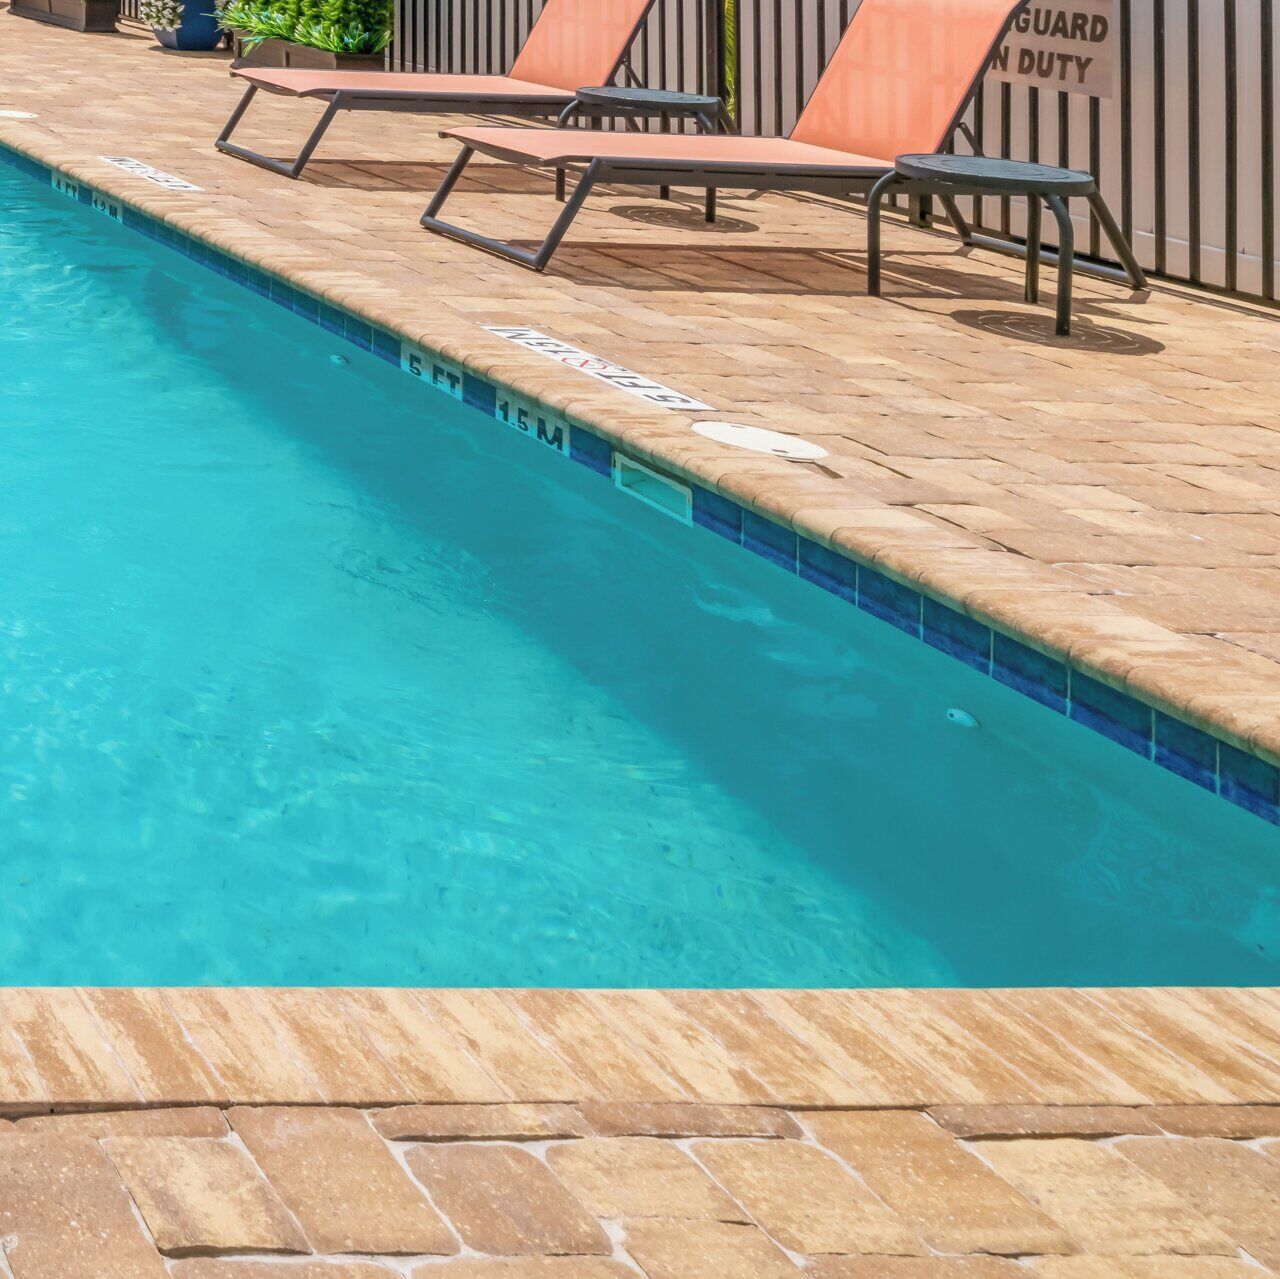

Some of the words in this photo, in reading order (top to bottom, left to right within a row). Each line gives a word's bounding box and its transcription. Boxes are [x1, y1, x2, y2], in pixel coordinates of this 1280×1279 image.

[1008, 7, 1109, 43] GUARD
[1017, 48, 1093, 84] DUTY
[408, 352, 422, 377] 5
[431, 363, 461, 391] FT
[536, 416, 564, 452] M
